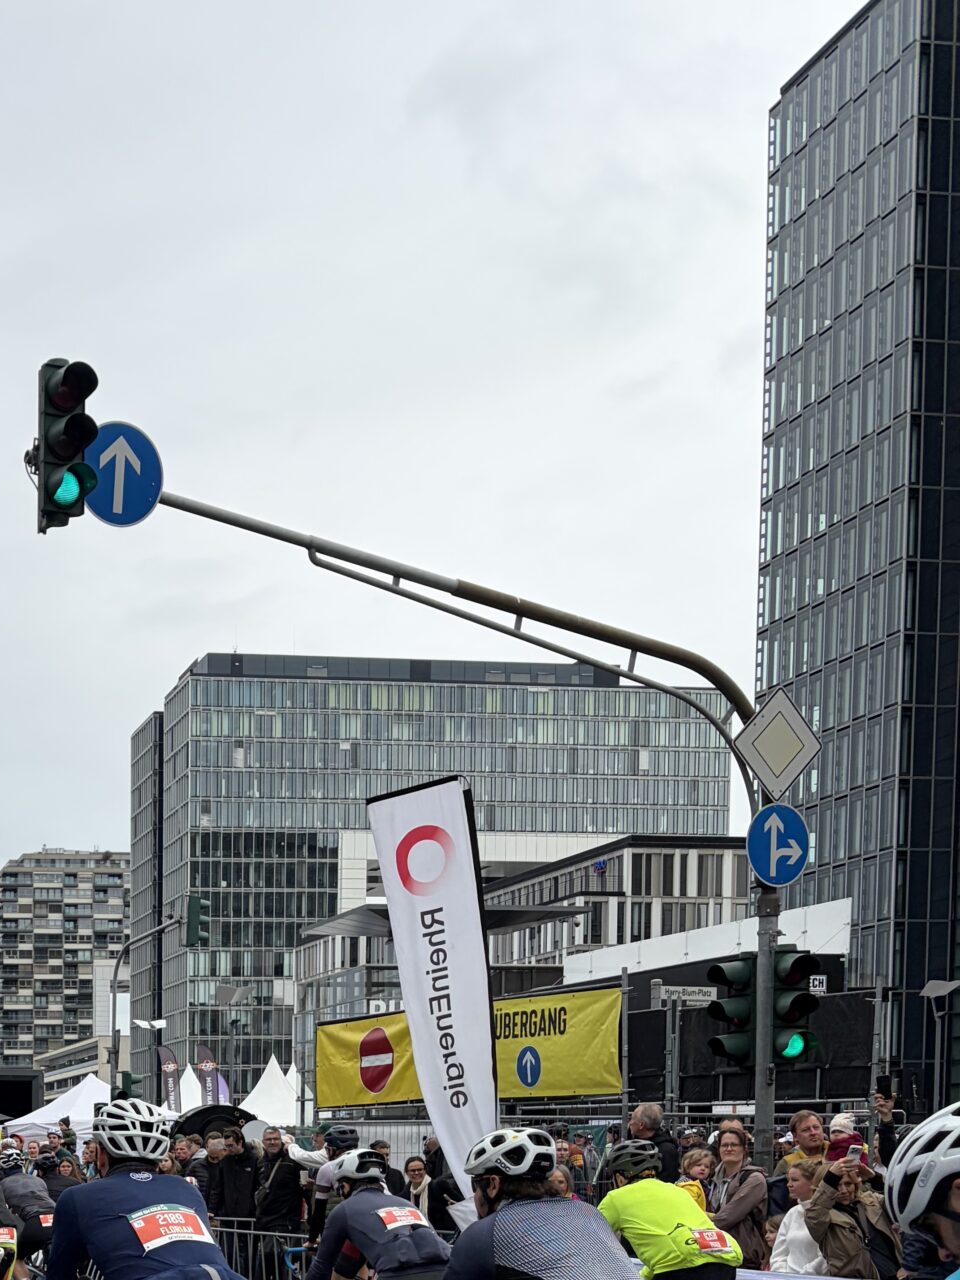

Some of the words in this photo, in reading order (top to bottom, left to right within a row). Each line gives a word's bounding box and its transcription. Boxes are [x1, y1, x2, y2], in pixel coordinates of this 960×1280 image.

[665, 988, 712, 998] Harry-Blum-Platz
[495, 1007, 567, 1040] ÜBERGANG
[495, 1158, 511, 1172] POC
[156, 1213, 186, 1225] 2189
[159, 1225, 194, 1236] FLORIAN
